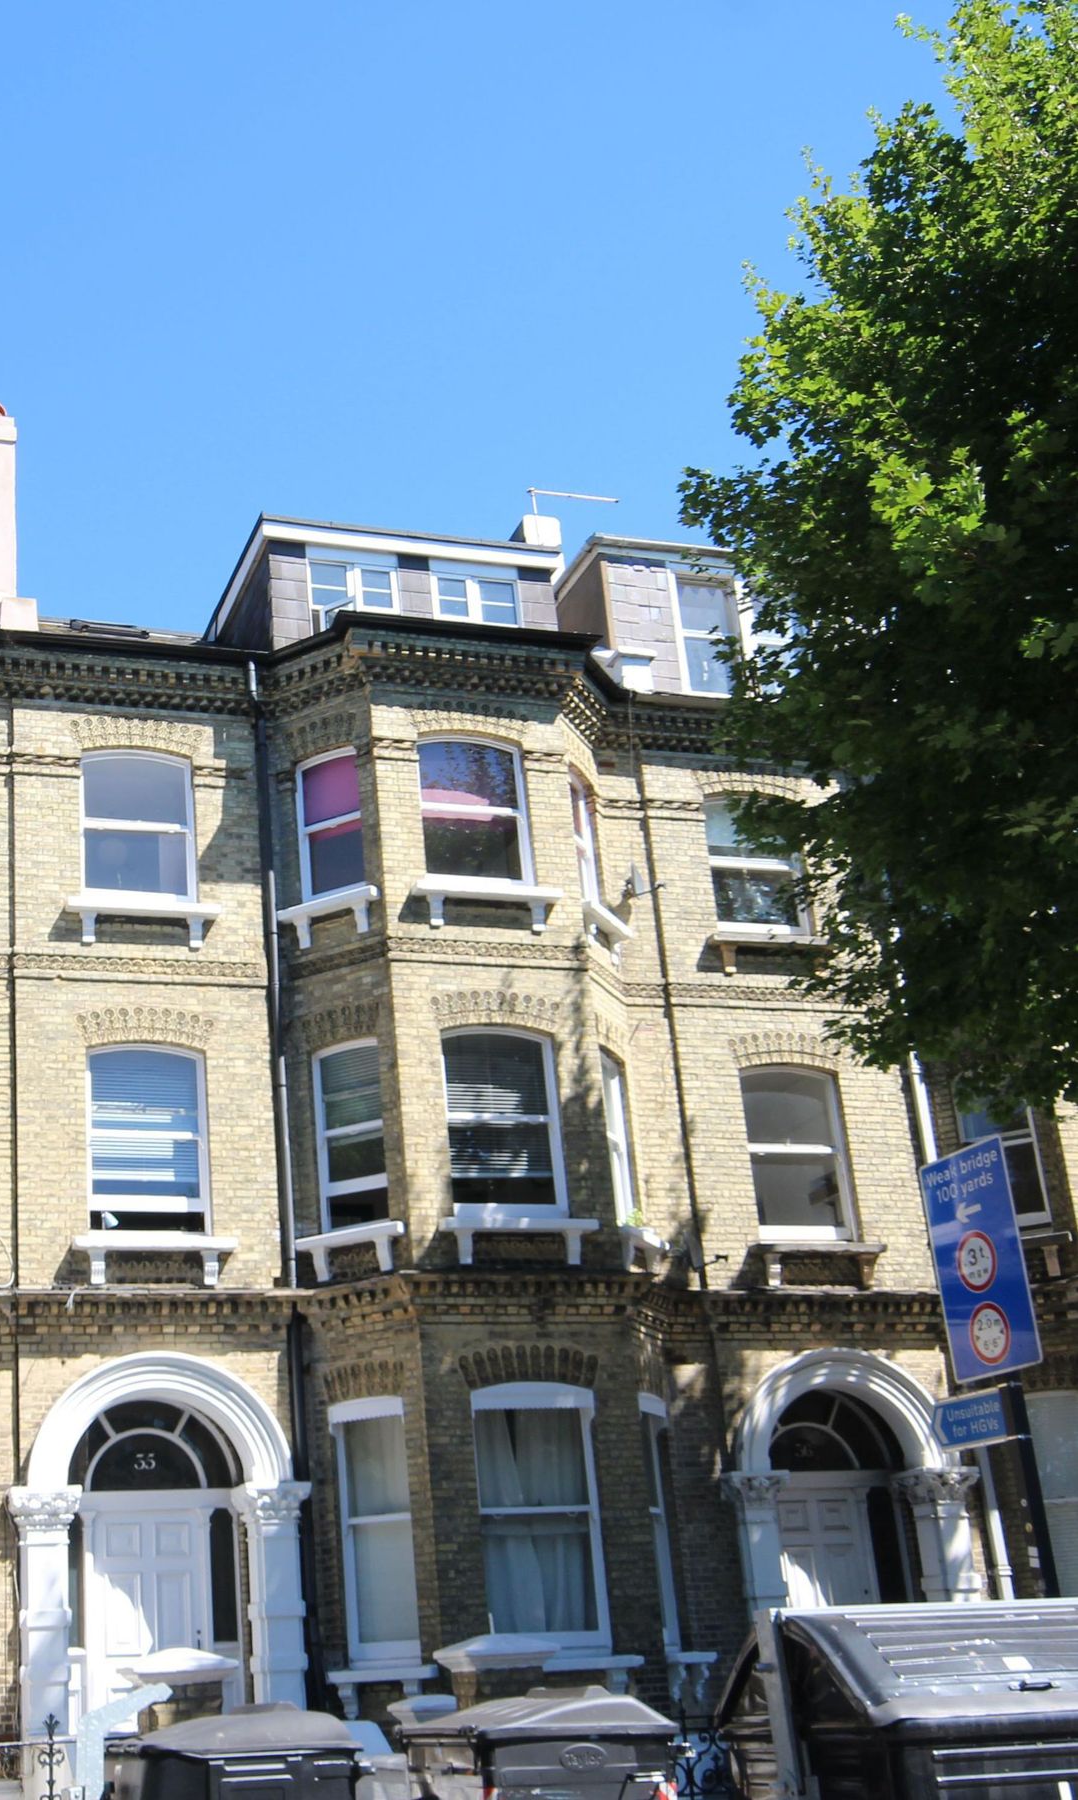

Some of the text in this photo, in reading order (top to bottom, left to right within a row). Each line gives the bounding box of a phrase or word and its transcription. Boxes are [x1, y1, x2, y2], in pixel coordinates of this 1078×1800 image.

[925, 1150, 998, 1187] Weak bridge
[936, 1172, 994, 1203] 100 yards
[968, 1248, 978, 1266] 3
[946, 1401, 1000, 1421] Unsuitable
[952, 1417, 999, 1438] for HGVs
